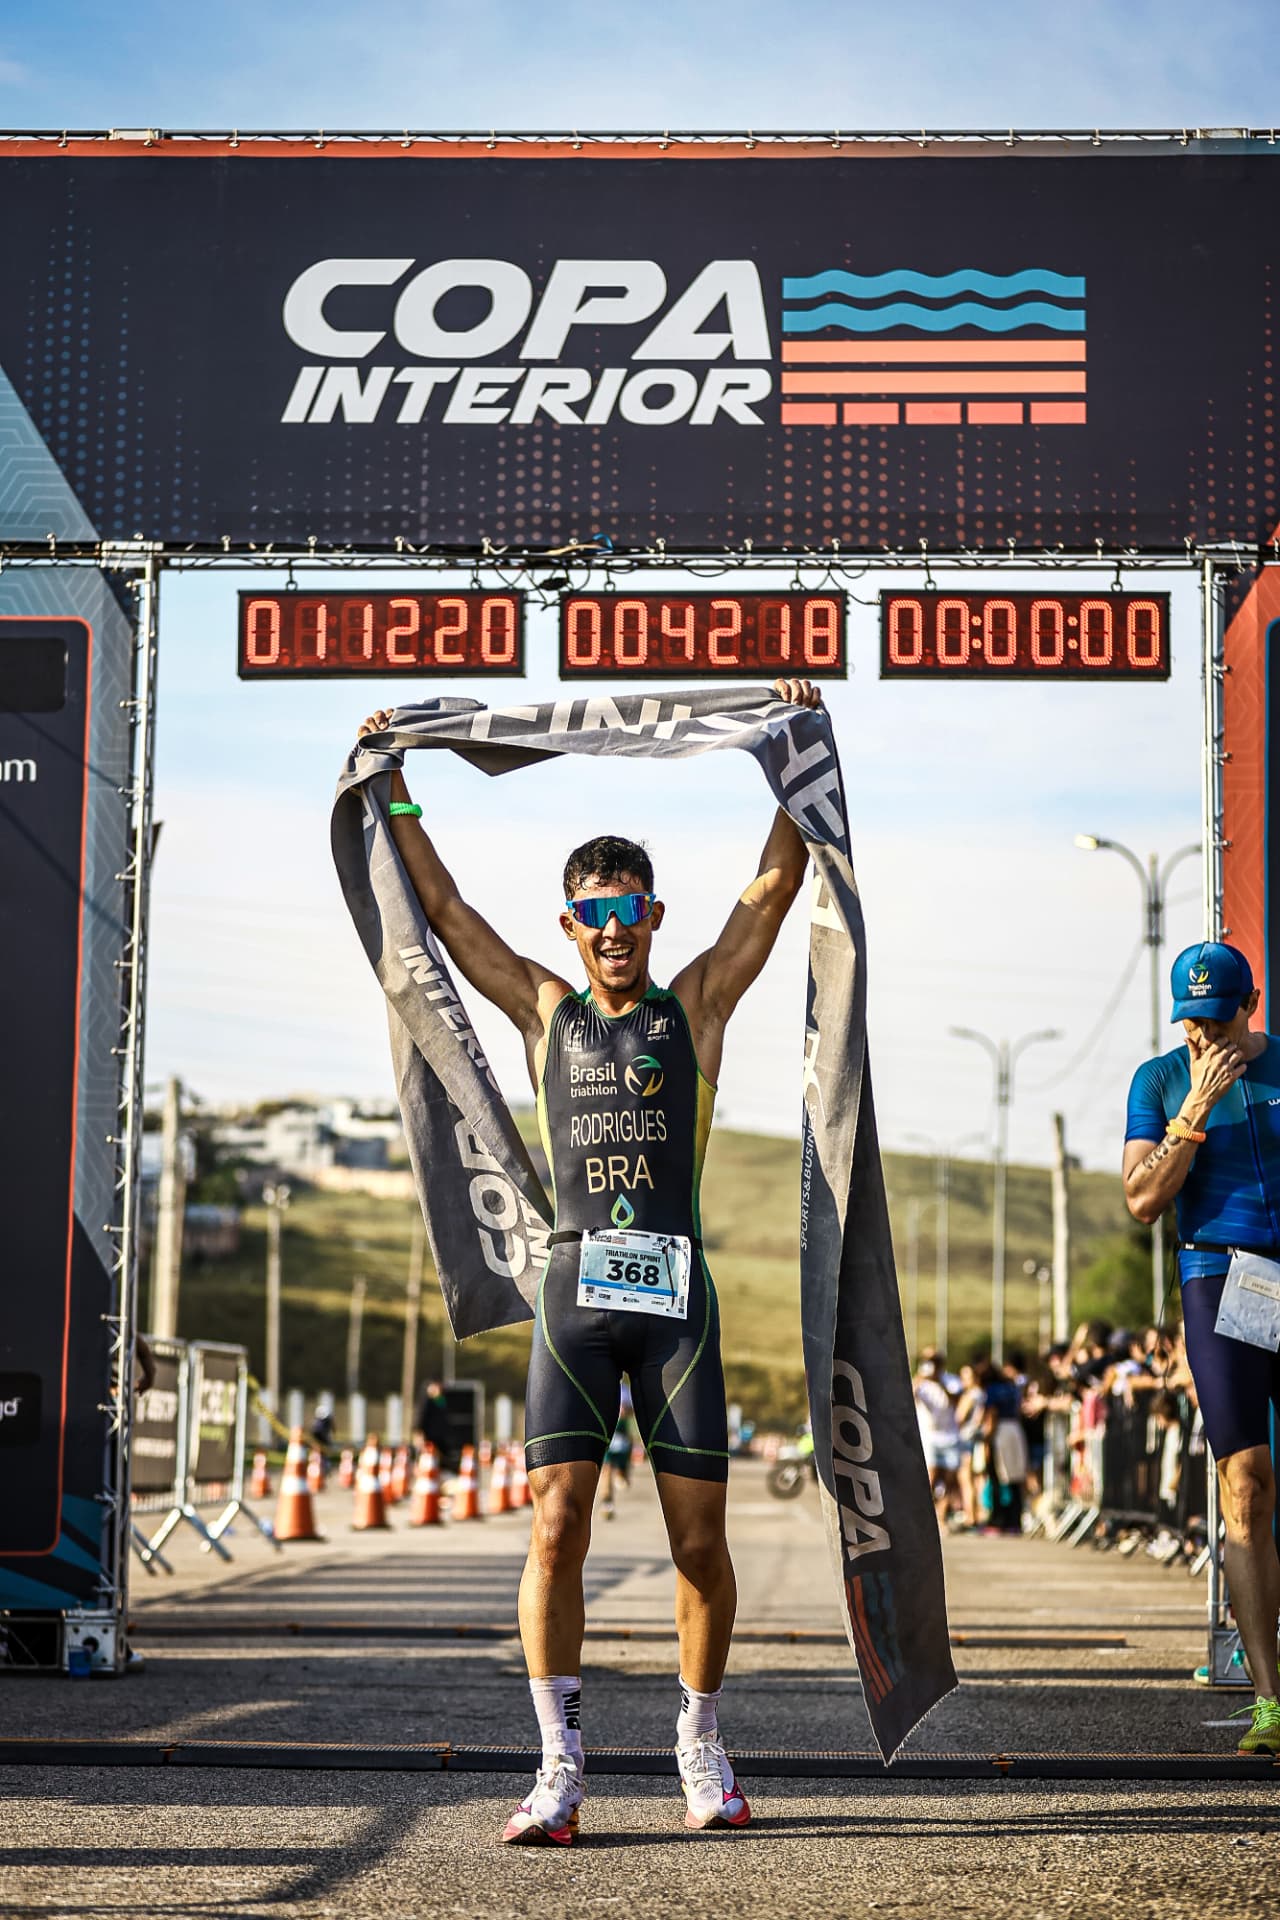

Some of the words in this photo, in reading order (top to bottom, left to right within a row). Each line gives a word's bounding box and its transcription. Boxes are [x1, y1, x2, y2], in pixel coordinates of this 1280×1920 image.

[282, 258, 773, 361] COPA
[280, 366, 773, 426] INTERIOR
[889, 600, 1161, 667] 00:00:00
[570, 1062, 617, 1084] Brasil
[570, 1084, 618, 1098] triathlon
[570, 1110, 667, 1149] RODRIGUES
[585, 1154, 655, 1194] BRA
[605, 1249, 638, 1260] TRIATHLON
[639, 1253, 661, 1263] SPRINT
[606, 1259, 660, 1287] 368
[831, 1358, 892, 1562] COPA
